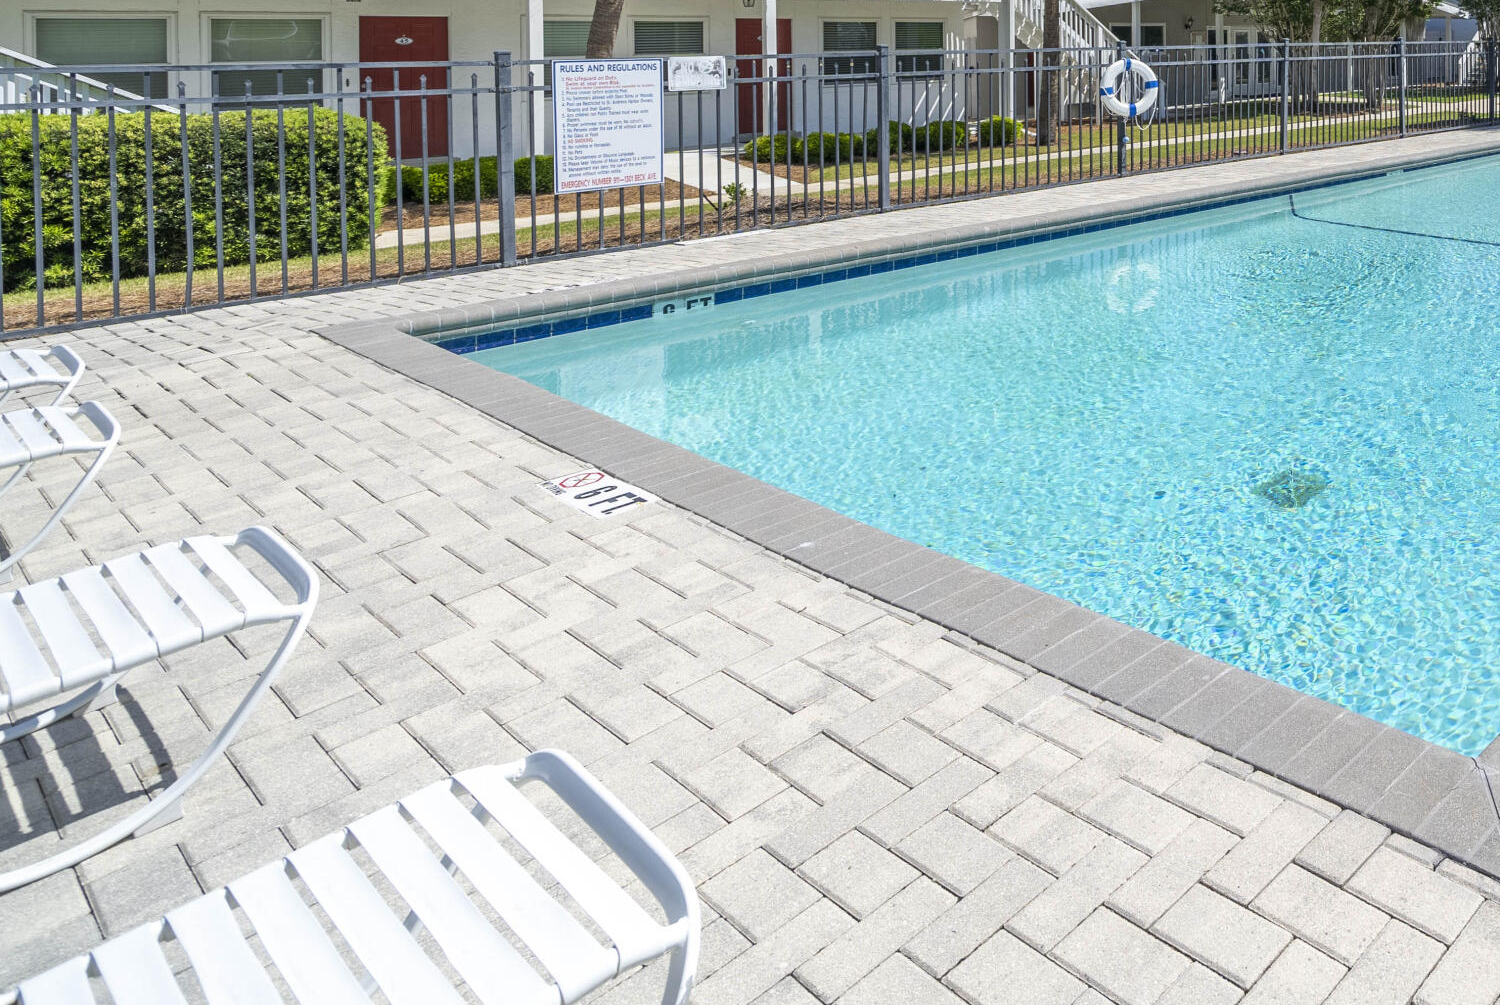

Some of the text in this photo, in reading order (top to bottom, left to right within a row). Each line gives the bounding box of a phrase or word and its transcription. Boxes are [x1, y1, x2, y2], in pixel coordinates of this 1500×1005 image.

[560, 63, 657, 73] RULES AND REGULATIONS
[561, 179, 591, 189] EMERGENCY
[591, 176, 612, 186] NUMBER
[634, 173, 646, 182] BECK
[647, 172, 657, 180] AVE
[686, 296, 712, 310] FT
[574, 485, 617, 499] 6
